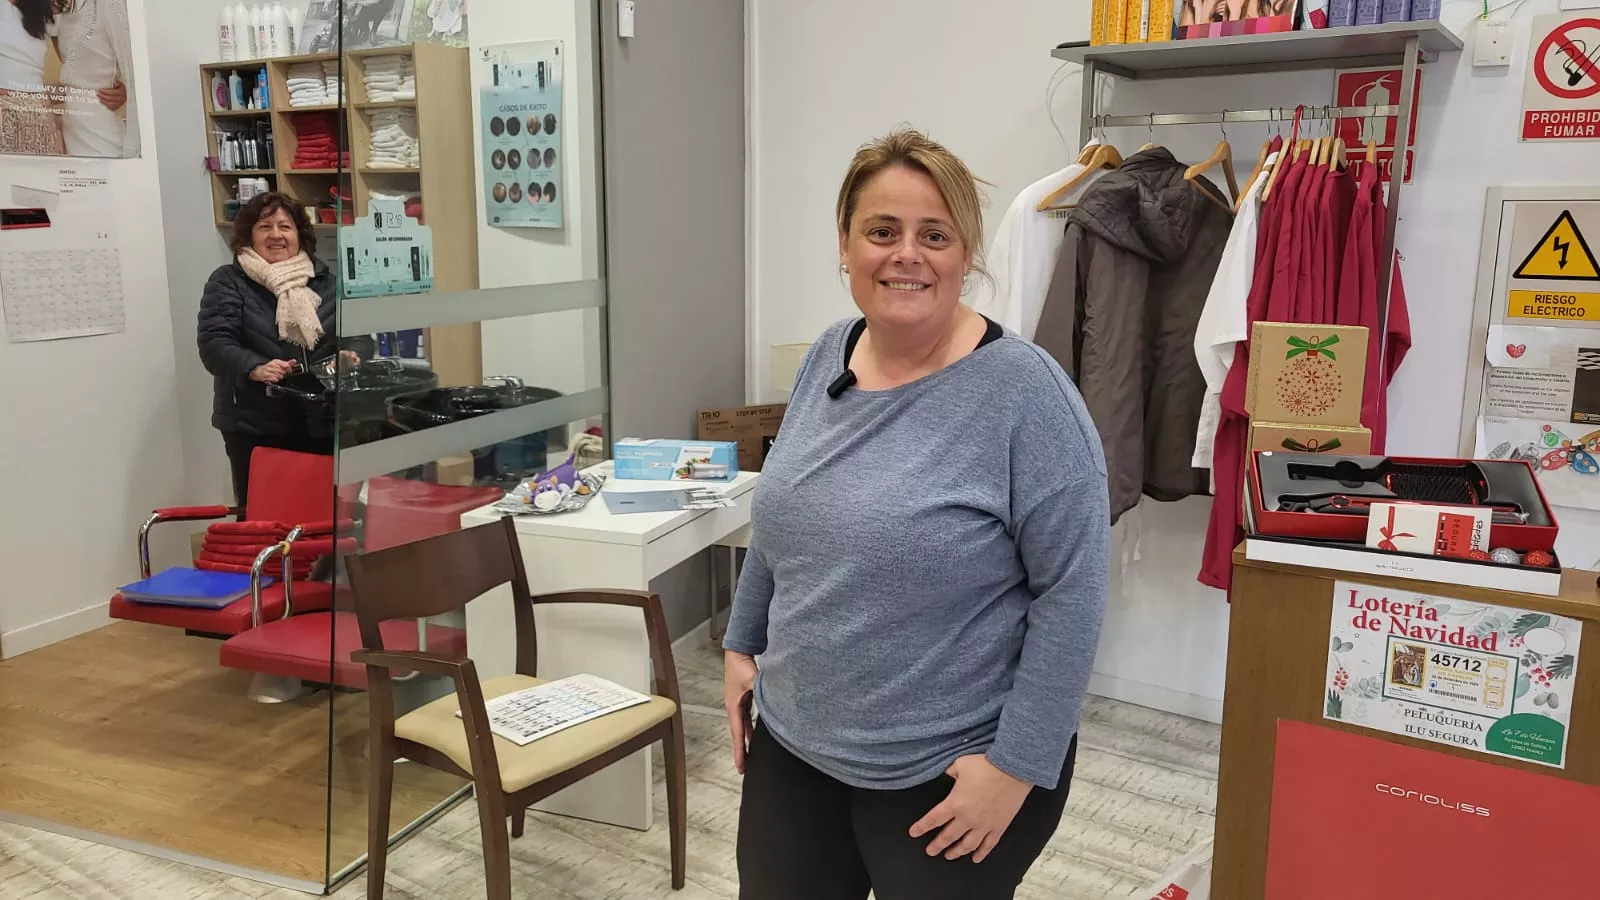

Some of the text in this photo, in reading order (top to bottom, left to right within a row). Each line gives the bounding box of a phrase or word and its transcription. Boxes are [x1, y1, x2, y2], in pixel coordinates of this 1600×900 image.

[7, 90, 29, 98] who
[31, 92, 48, 100] you
[50, 94, 73, 102] want
[58, 84, 68, 93] of
[70, 86, 96, 96] being
[1544, 125, 1595, 137] FUMAR
[1534, 294, 1577, 305] RIESGO
[1523, 305, 1586, 318] ELECTRICO
[1348, 589, 1439, 621] Lotería
[1352, 610, 1498, 651] de Navidad
[1431, 653, 1482, 673] 45712
[1404, 708, 1483, 732] PELUQUERÍA
[1405, 724, 1479, 747] ILU SEGURA
